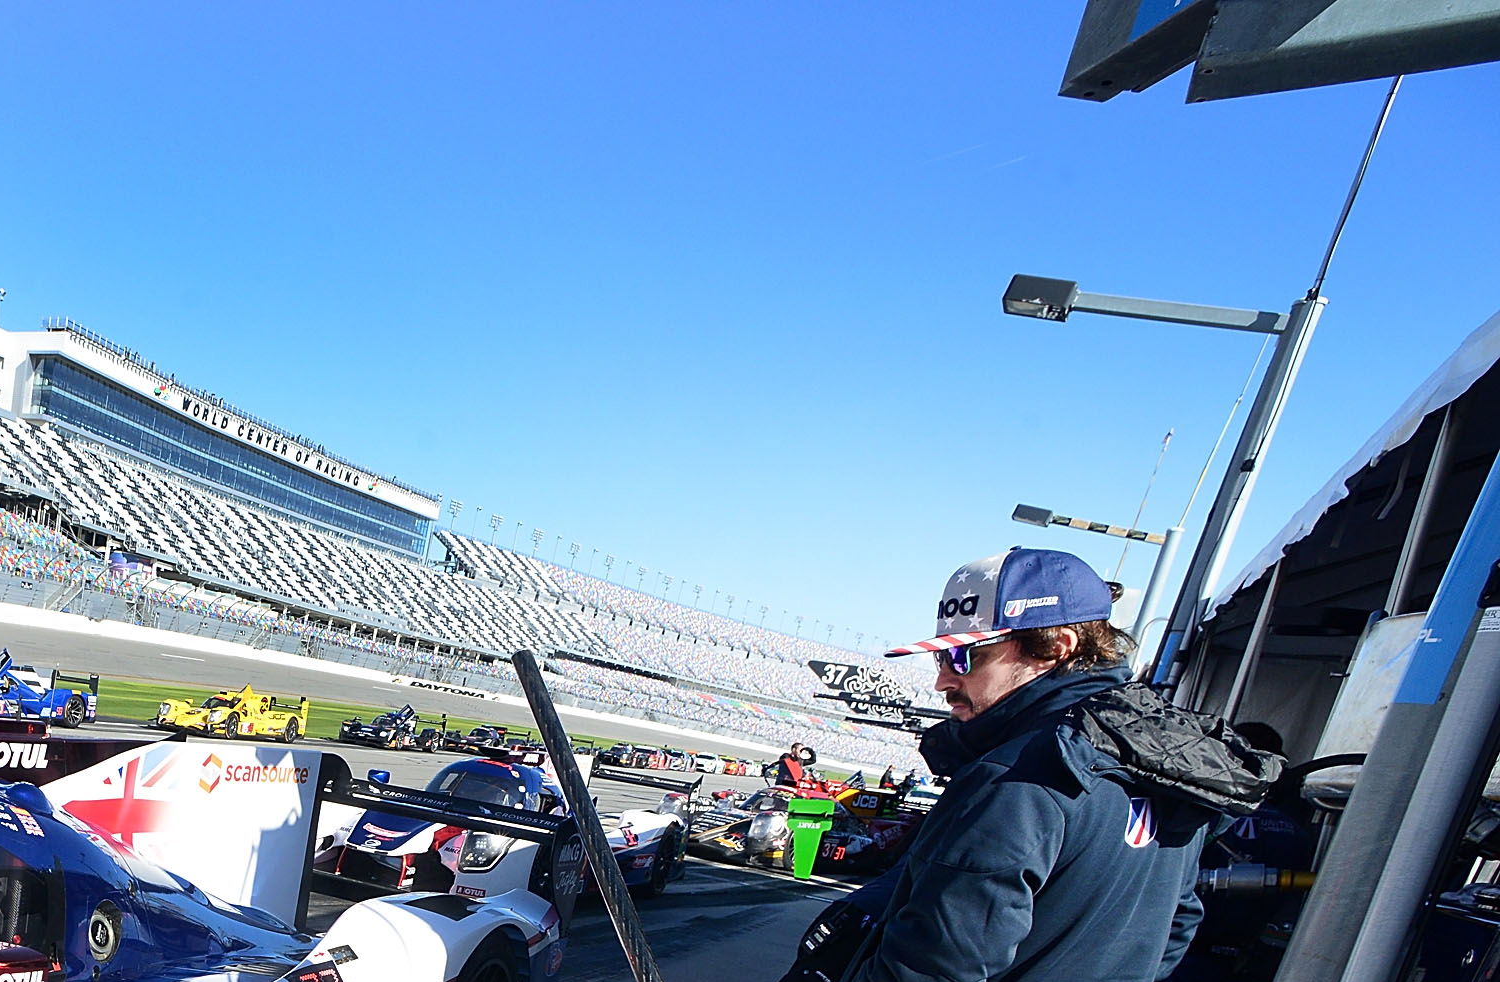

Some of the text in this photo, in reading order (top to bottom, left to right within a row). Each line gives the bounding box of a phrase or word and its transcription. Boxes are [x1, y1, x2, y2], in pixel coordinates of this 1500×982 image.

[182, 396, 360, 487] WORLD CENTER OF RACING
[821, 663, 849, 686] 37
[409, 681, 485, 699] DAYTONA
[224, 762, 309, 786] scansource
[382, 790, 449, 806] CROWDSTRIKE
[852, 794, 878, 809] JCB
[822, 843, 837, 857] 37
[833, 846, 846, 860] 37
